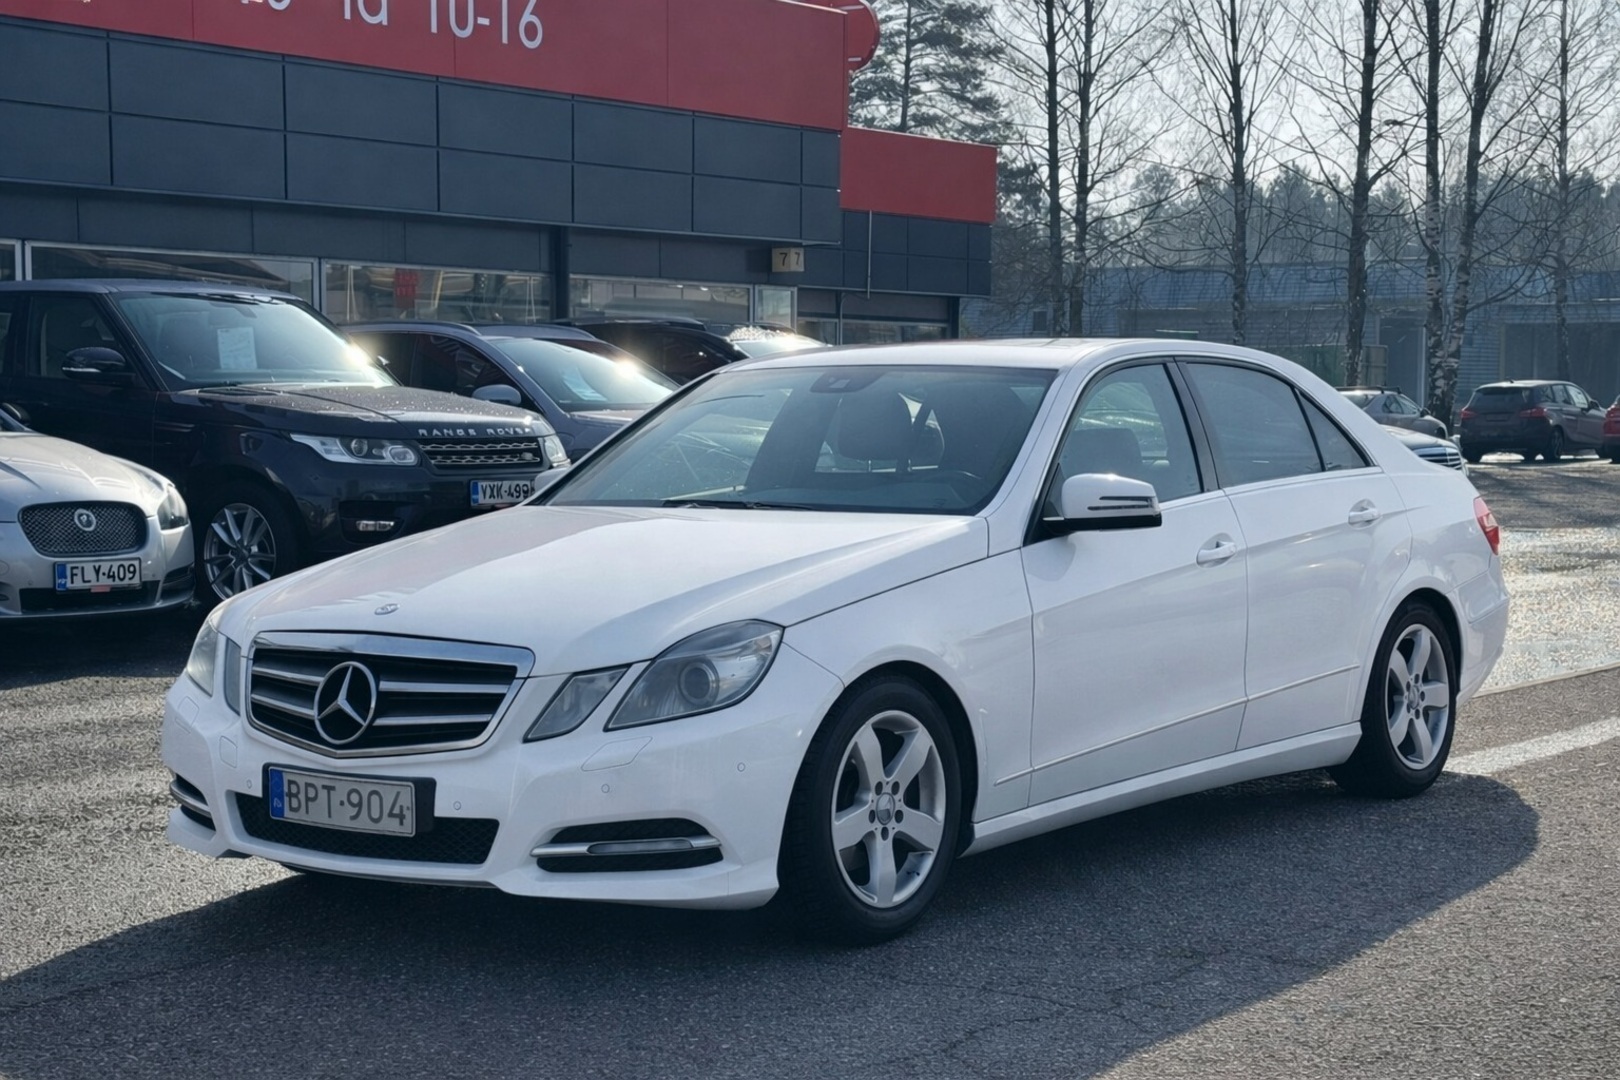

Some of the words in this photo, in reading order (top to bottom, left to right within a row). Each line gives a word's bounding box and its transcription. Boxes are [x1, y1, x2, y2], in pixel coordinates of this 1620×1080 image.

[430, 0, 543, 49] 10-16
[779, 252, 788, 266] 7
[418, 428, 477, 436] RANGE
[287, 779, 407, 827] BPT-904
